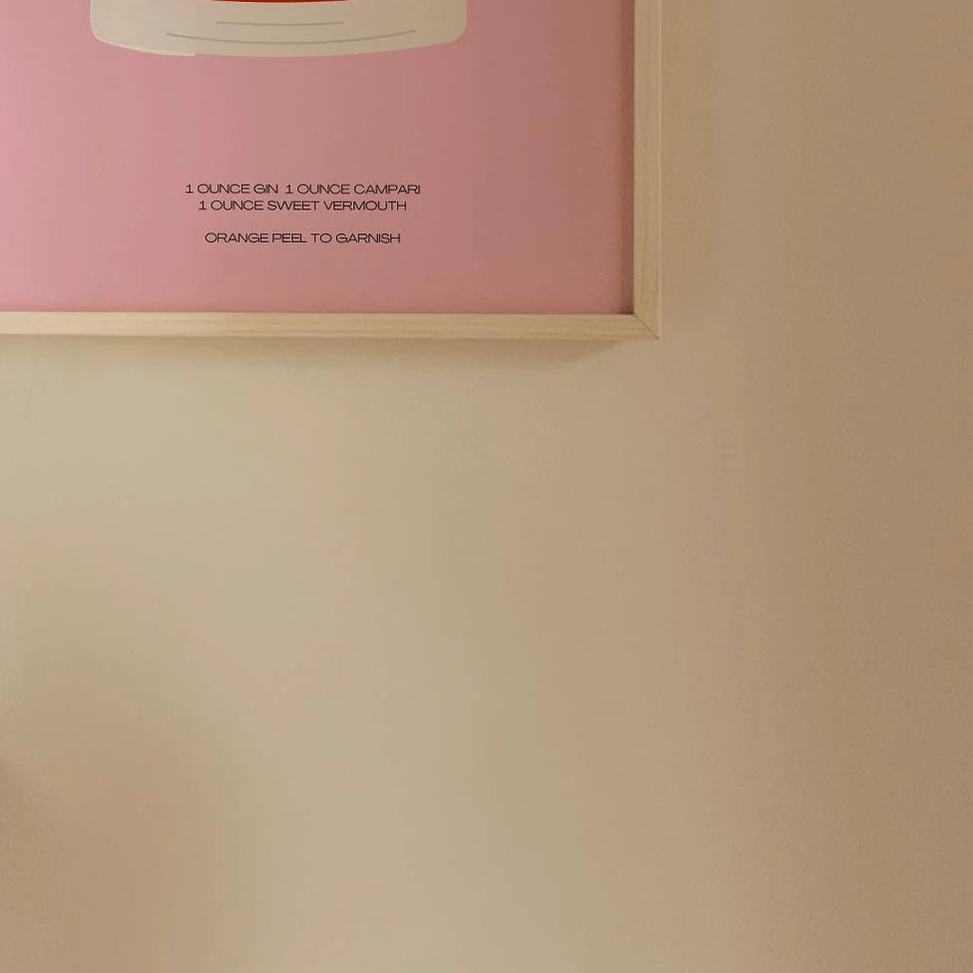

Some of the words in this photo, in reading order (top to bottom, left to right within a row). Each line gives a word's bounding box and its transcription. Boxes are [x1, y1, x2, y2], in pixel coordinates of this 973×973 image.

[185, 183, 194, 195] 1
[197, 183, 250, 195] OUNCE
[253, 183, 279, 195] GIN
[285, 183, 292, 195] 1
[296, 183, 350, 195] OUNCE
[354, 183, 421, 195] CAMPARI
[198, 200, 207, 211] 1
[210, 200, 264, 212] OUNCE
[267, 200, 320, 212] SWEET
[323, 200, 407, 212] VERMOUTH
[204, 232, 269, 244] ORANGE
[272, 232, 307, 244] PEEL
[310, 232, 332, 244] TO
[335, 232, 401, 244] GARNISH
